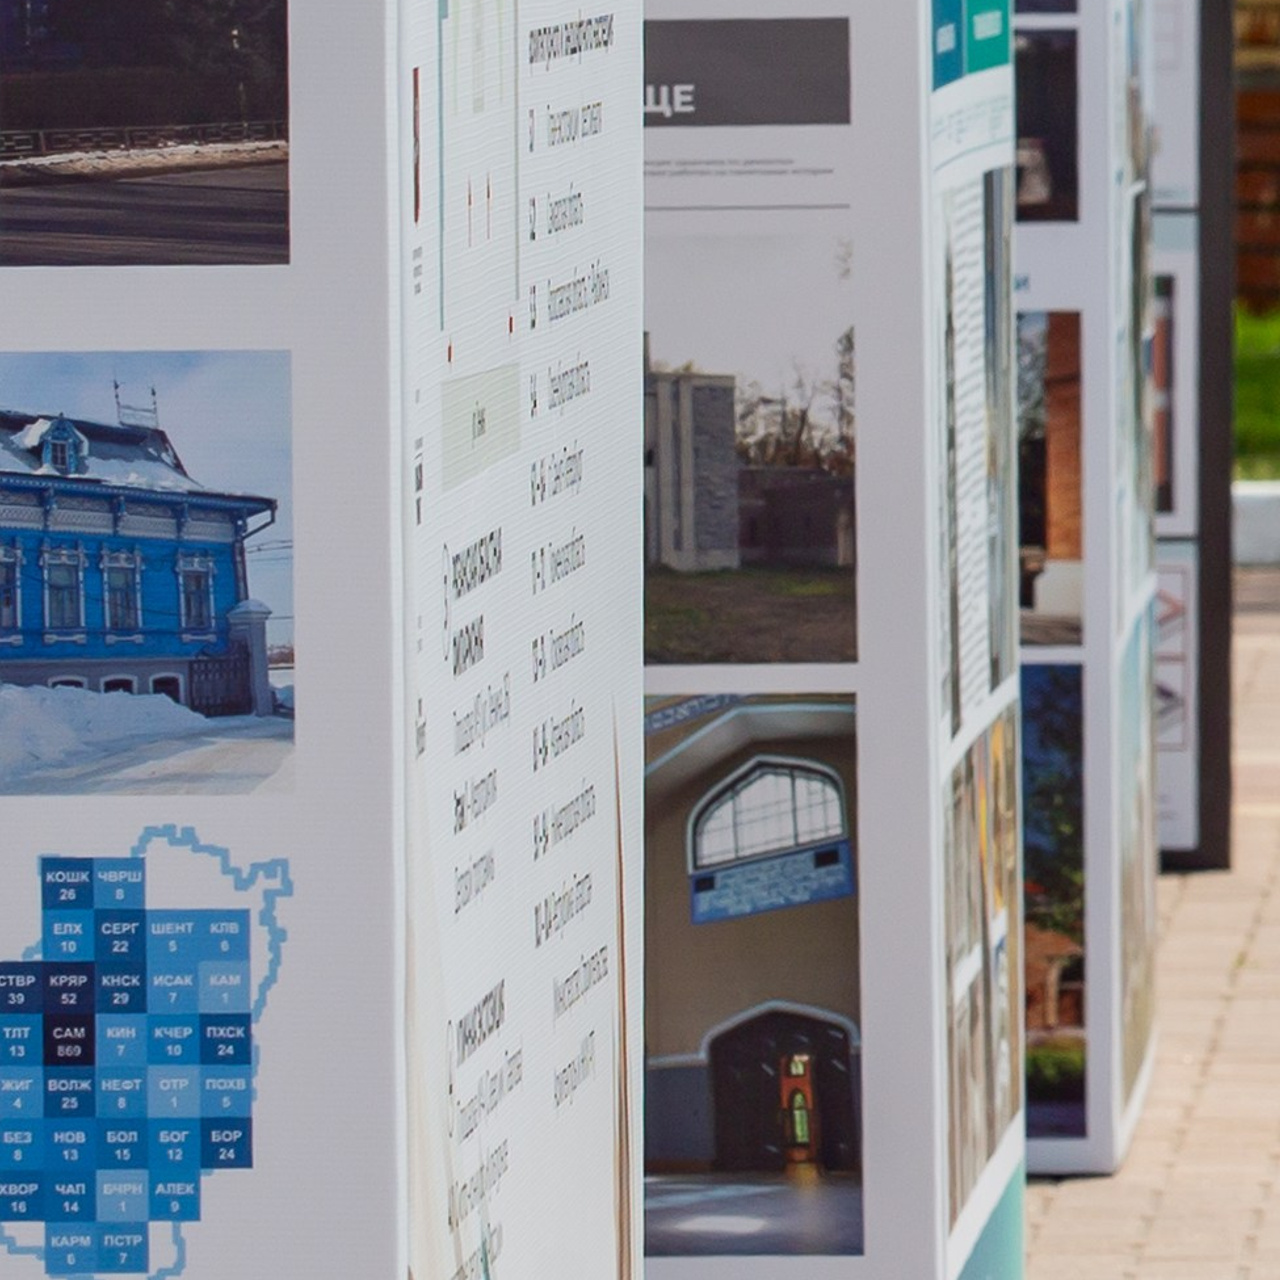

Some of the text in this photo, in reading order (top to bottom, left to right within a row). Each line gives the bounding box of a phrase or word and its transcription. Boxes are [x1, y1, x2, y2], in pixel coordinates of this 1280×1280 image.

[46, 871, 89, 883] КОШК
[98, 871, 142, 883] ЧВРШ
[60, 888, 76, 900] 26
[53, 923, 82, 935] ЕЛХ
[101, 922, 139, 935] СЕРГ
[151, 922, 193, 935] ШЕНТ
[61, 941, 76, 952] 10
[112, 940, 128, 952] 22
[0, 975, 36, 987] СТВР
[50, 975, 87, 987] КРЯР
[102, 975, 140, 987] КНСК
[153, 975, 192, 987] ИСАК
[9, 993, 25, 1005] 39
[61, 993, 76, 1005] 52
[113, 992, 129, 1004] 29
[169, 992, 177, 1002] 7
[3, 1027, 30, 1039] ТЛТ
[52, 1027, 85, 1039] САМ
[107, 1027, 135, 1038] КИН
[154, 1027, 193, 1039] КЧЕР
[206, 1026, 244, 1038] ПХСК
[9, 1045, 25, 1057] 13
[57, 1045, 82, 1057] 869
[117, 1044, 125, 1055] 7
[166, 1045, 182, 1056] 10
[218, 1044, 234, 1056] 24
[1, 1080, 32, 1091] ЖИГ
[48, 1079, 90, 1092] ВОЛЖ
[102, 1079, 141, 1091] НЕФТ
[159, 1078, 189, 1091] ОТР
[206, 1078, 246, 1090] ПОХВ
[13, 1097, 22, 1109] 4
[62, 1097, 78, 1109] 25
[171, 1096, 177, 1108] 1
[3, 1132, 31, 1143] БЕЗ
[54, 1132, 86, 1143] НОВ
[107, 1131, 137, 1143] БОЛ
[159, 1131, 189, 1143] БОГ
[211, 1130, 242, 1142] БОР
[63, 1149, 78, 1160] 13
[115, 1149, 131, 1160] 15
[167, 1148, 182, 1160] 12
[219, 1148, 235, 1160] 24
[0, 1183, 38, 1195] ХВОР
[55, 1183, 85, 1195] ЧАП
[156, 1183, 194, 1195] АЛЕК
[11, 1201, 27, 1213] 16
[63, 1201, 79, 1212] 14
[120, 1201, 126, 1212] 1
[171, 1201, 180, 1212] 9
[51, 1236, 91, 1247] КАРМ
[104, 1235, 143, 1246] ПСТР
[119, 1252, 127, 1263] 7
